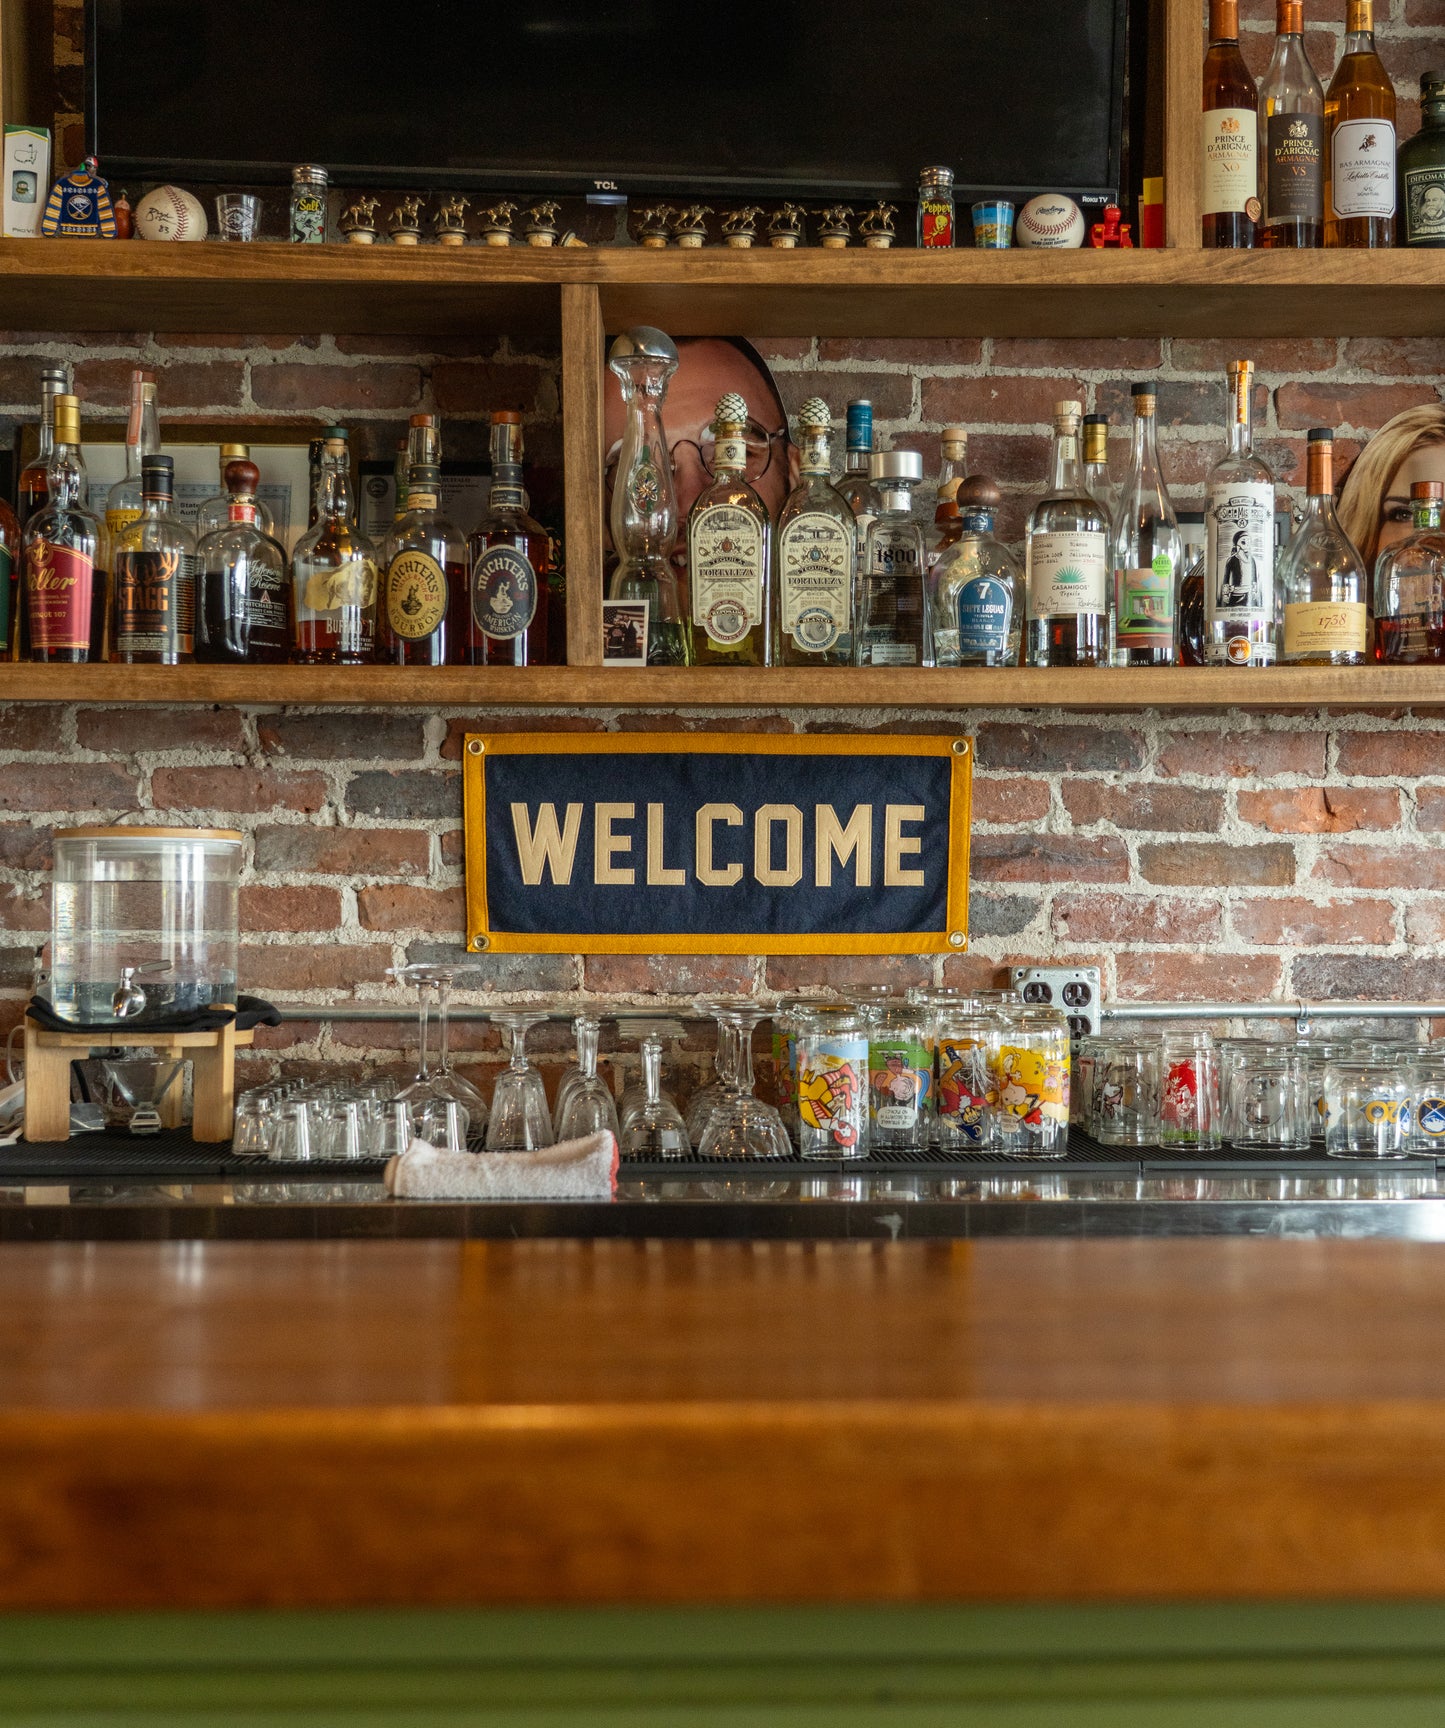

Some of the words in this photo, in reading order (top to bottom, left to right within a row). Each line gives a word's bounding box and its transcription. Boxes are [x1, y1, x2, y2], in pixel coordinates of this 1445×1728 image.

[1215, 135, 1245, 143] PRINCE
[1207, 143, 1252, 152] D'ARIGNAC
[1283, 140, 1314, 148] PRINCE
[1274, 147, 1320, 156] D'ARIGNAC
[1275, 155, 1319, 164] ARMAGNAC
[1222, 163, 1240, 172] XO
[1292, 166, 1307, 176] VS
[593, 181, 618, 190] TCL
[1099, 196, 1108, 204] TV
[299, 199, 319, 211] Salt
[922, 201, 951, 215] Pepper
[876, 549, 916, 563] 1800
[788, 577, 842, 585] FORTALEZA
[979, 582, 990, 600] 7
[391, 607, 439, 632] BOURBON
[482, 612, 522, 627] AMERICAN
[1318, 613, 1347, 629] 1738
[510, 802, 926, 887] WELCOME
